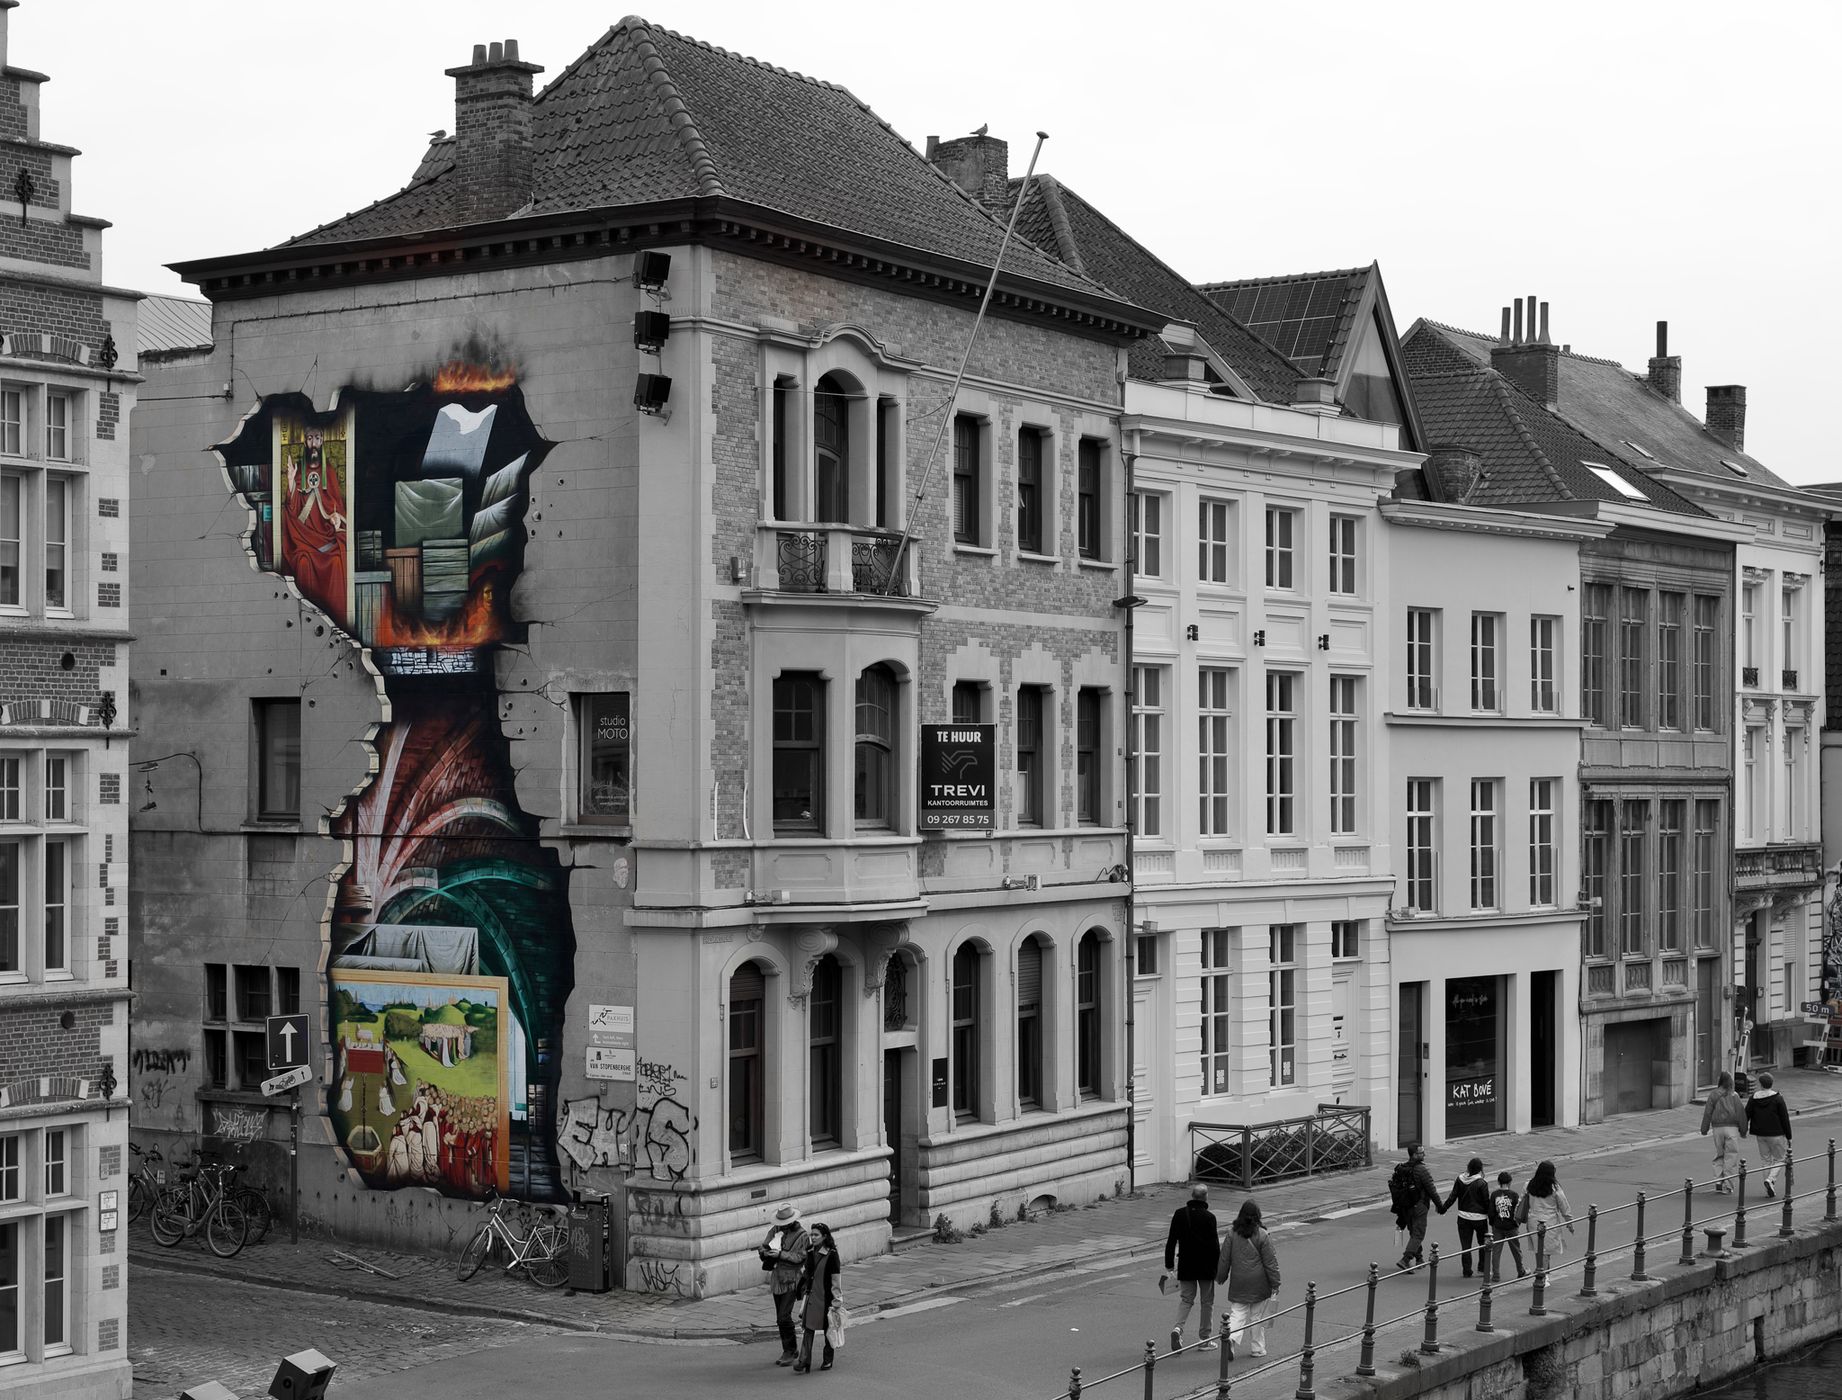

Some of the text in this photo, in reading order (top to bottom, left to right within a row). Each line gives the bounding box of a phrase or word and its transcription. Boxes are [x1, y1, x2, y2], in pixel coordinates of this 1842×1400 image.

[599, 714, 626, 726] studio
[597, 728, 629, 740] MOTO
[937, 731, 982, 743] TE HUUR
[930, 784, 985, 797] TREVI
[927, 815, 990, 824] 09 267 85 75
[1806, 1004, 1819, 1013] 50
[1453, 1079, 1493, 1099] KAT BOVÉ
